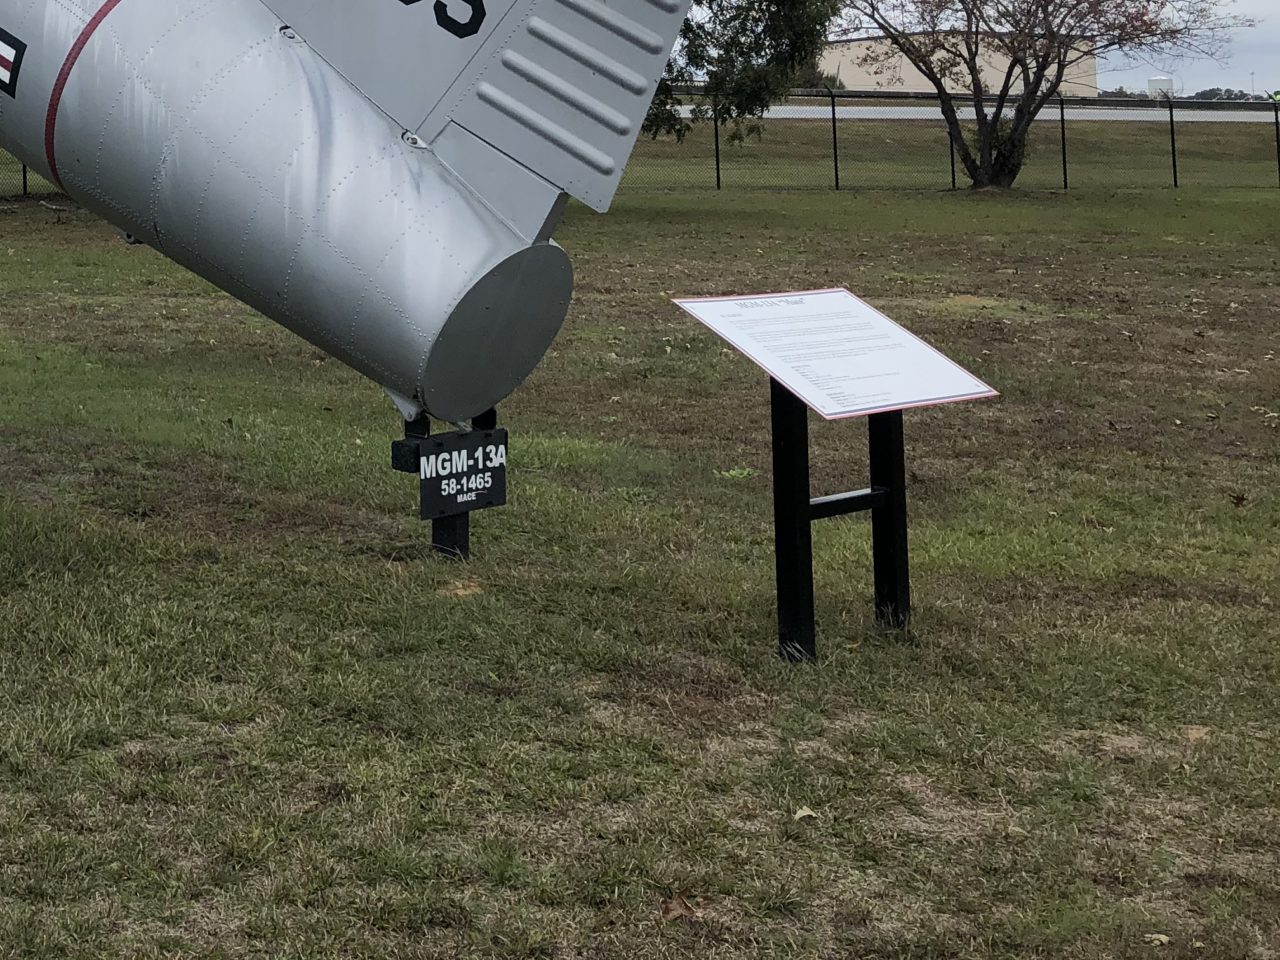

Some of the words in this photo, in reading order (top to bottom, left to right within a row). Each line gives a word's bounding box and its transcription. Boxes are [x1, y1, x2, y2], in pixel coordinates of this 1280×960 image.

[420, 444, 506, 479] MGM-13A
[441, 472, 492, 495] 58-1465
[456, 492, 476, 502] MACE
